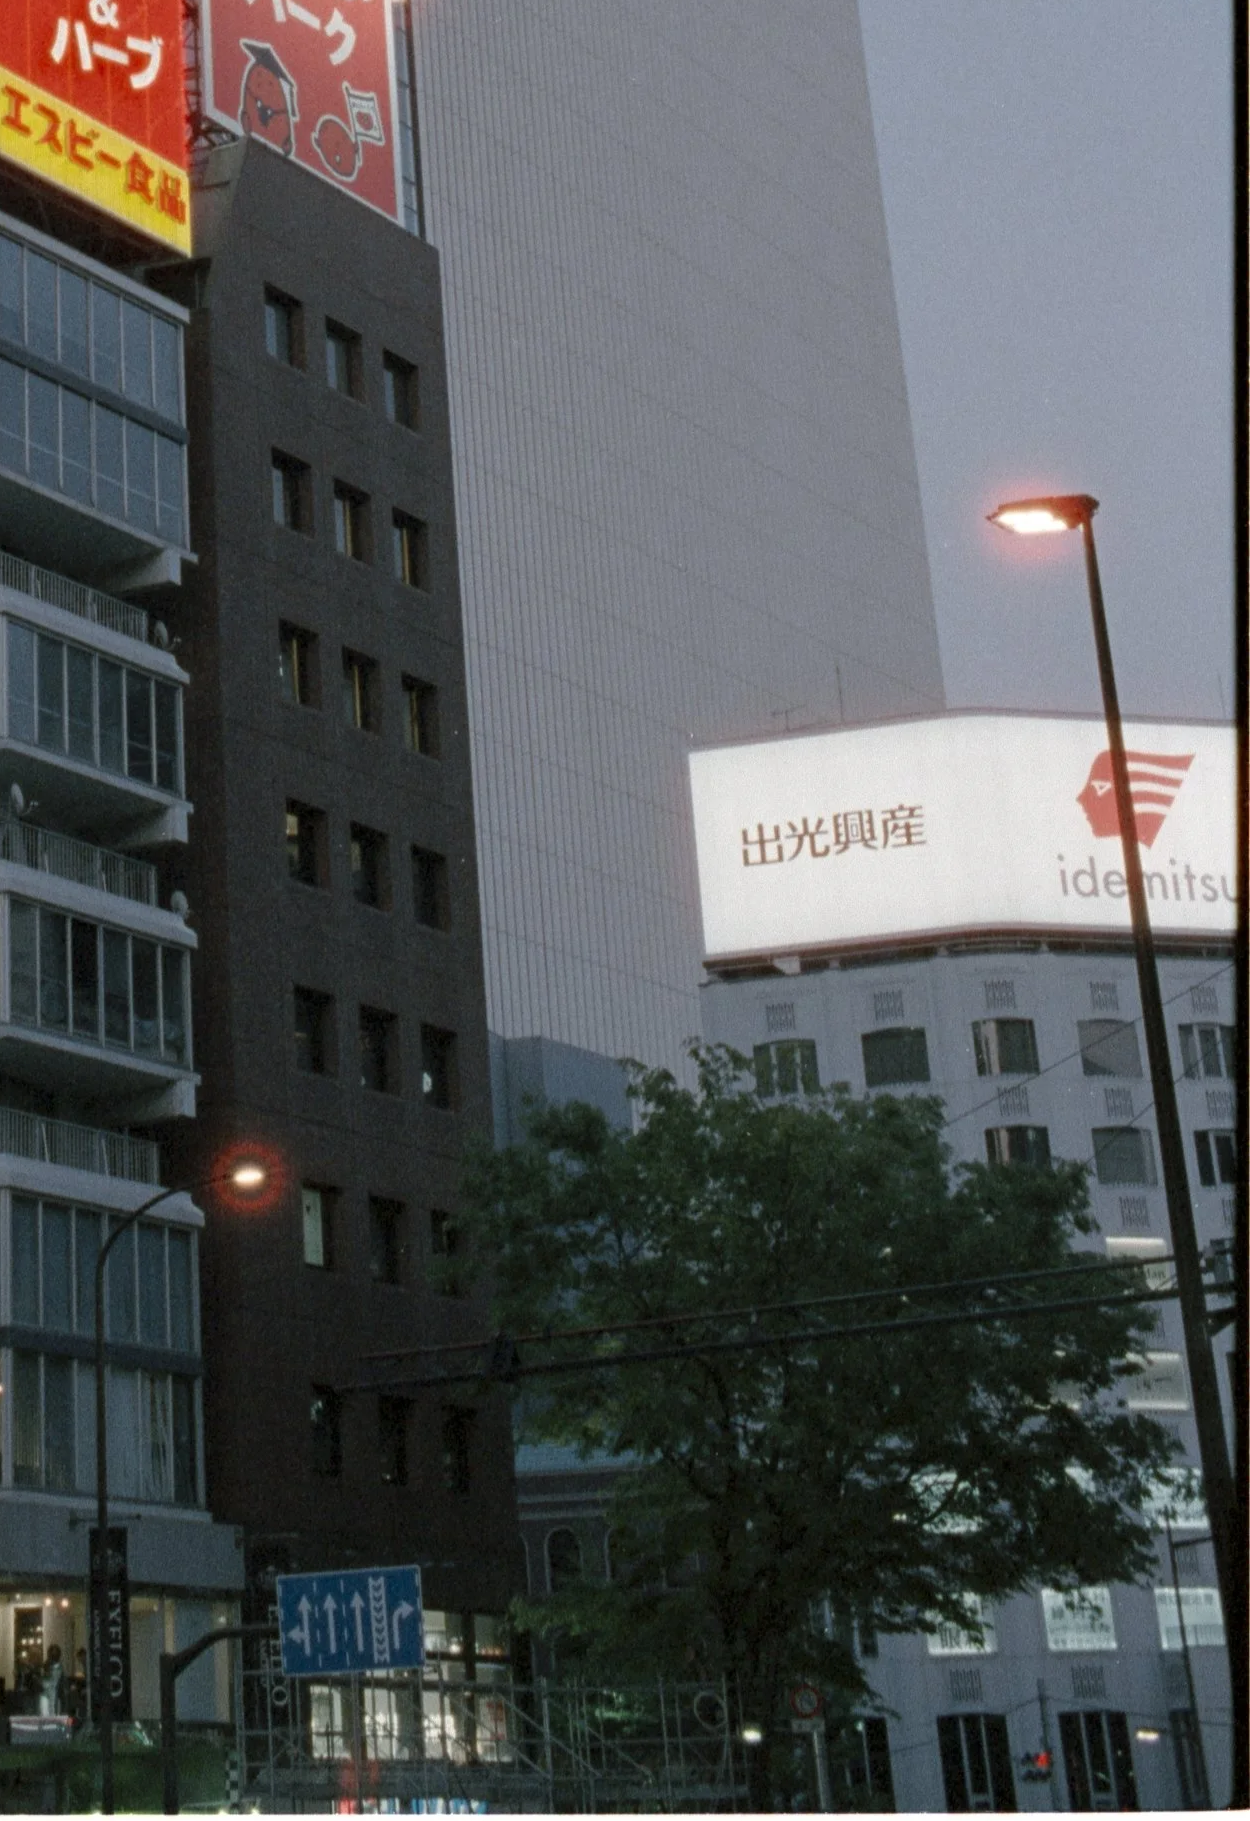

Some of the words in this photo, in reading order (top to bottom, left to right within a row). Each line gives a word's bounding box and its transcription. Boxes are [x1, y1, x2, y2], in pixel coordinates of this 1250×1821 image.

[50, 18, 164, 91] ハーブ
[0, 85, 187, 226] エスビー食品
[740, 804, 928, 867] 出光興産
